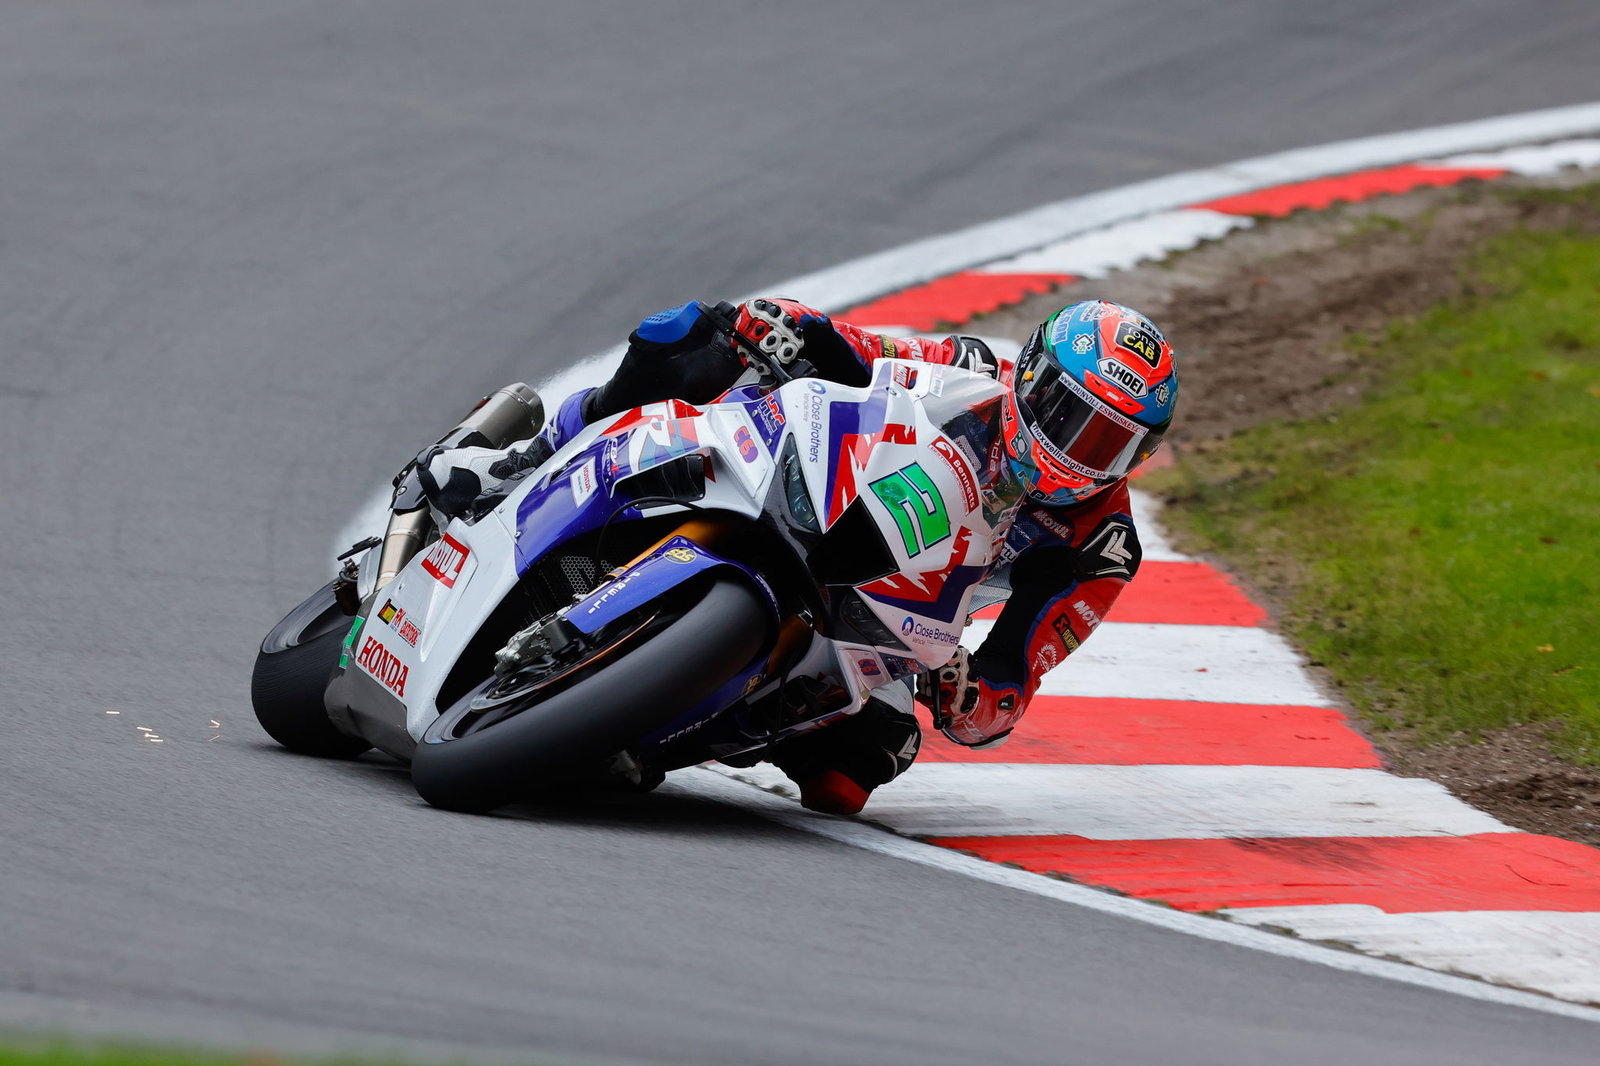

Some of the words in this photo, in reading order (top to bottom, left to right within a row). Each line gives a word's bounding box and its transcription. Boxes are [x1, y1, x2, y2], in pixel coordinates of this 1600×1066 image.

[1123, 335, 1155, 360] CAB
[1127, 326, 1156, 350] fona
[1104, 361, 1144, 395] SHOEI
[811, 395, 823, 420] Close
[809, 422, 822, 463] Brothers
[1033, 423, 1107, 479] maxwellfreight.co.uk
[953, 459, 975, 508] Bennetts
[868, 461, 952, 559] 2
[588, 571, 641, 615] PIRELLI
[915, 623, 933, 638] Close
[934, 628, 960, 645] Brothers
[1072, 600, 1100, 632] MOT
[358, 635, 409, 698] HONDA
